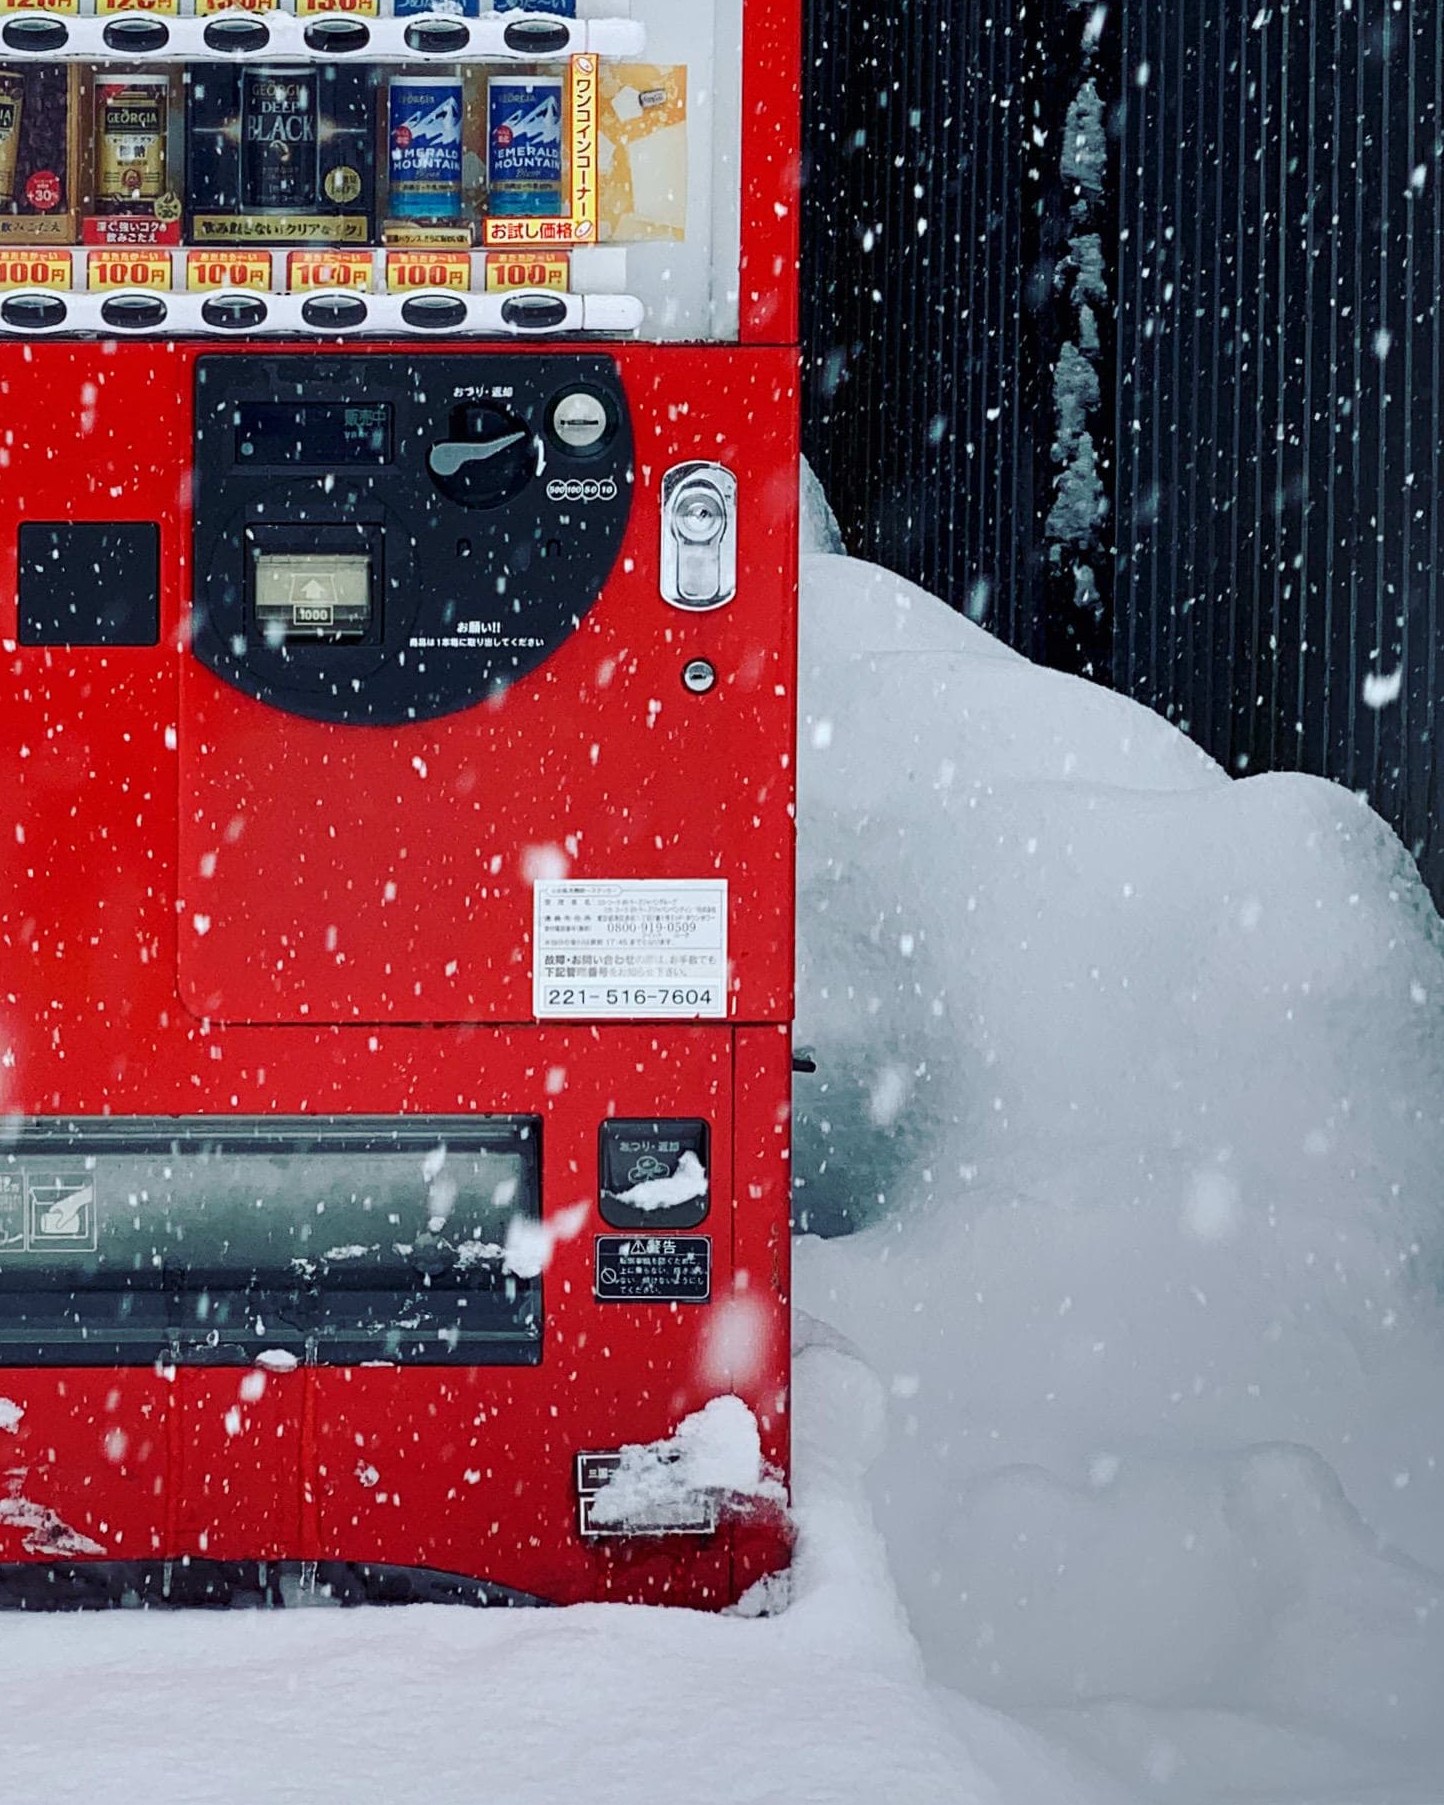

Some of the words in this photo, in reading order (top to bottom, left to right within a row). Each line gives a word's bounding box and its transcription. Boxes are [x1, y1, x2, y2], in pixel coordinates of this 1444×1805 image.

[106, 107, 158, 126] GEORGIA
[247, 114, 314, 142] BLACK
[391, 146, 459, 161] MERALD
[497, 145, 560, 159] EMERALD
[576, 79, 592, 217] ワンコインコーナー
[494, 157, 561, 171] MOUNTAIN
[490, 222, 573, 240] お試し価格
[95, 262, 165, 284] 100円
[193, 263, 264, 285] 100円
[393, 264, 463, 286] 100円
[492, 264, 562, 286] 100円
[452, 385, 514, 399] おつり・返却
[600, 484, 614, 495] 10
[299, 609, 329, 622] 1000
[456, 619, 502, 634] お願い!!
[547, 988, 713, 1006] 221-516-7604
[618, 1140, 681, 1153] おつり・返却
